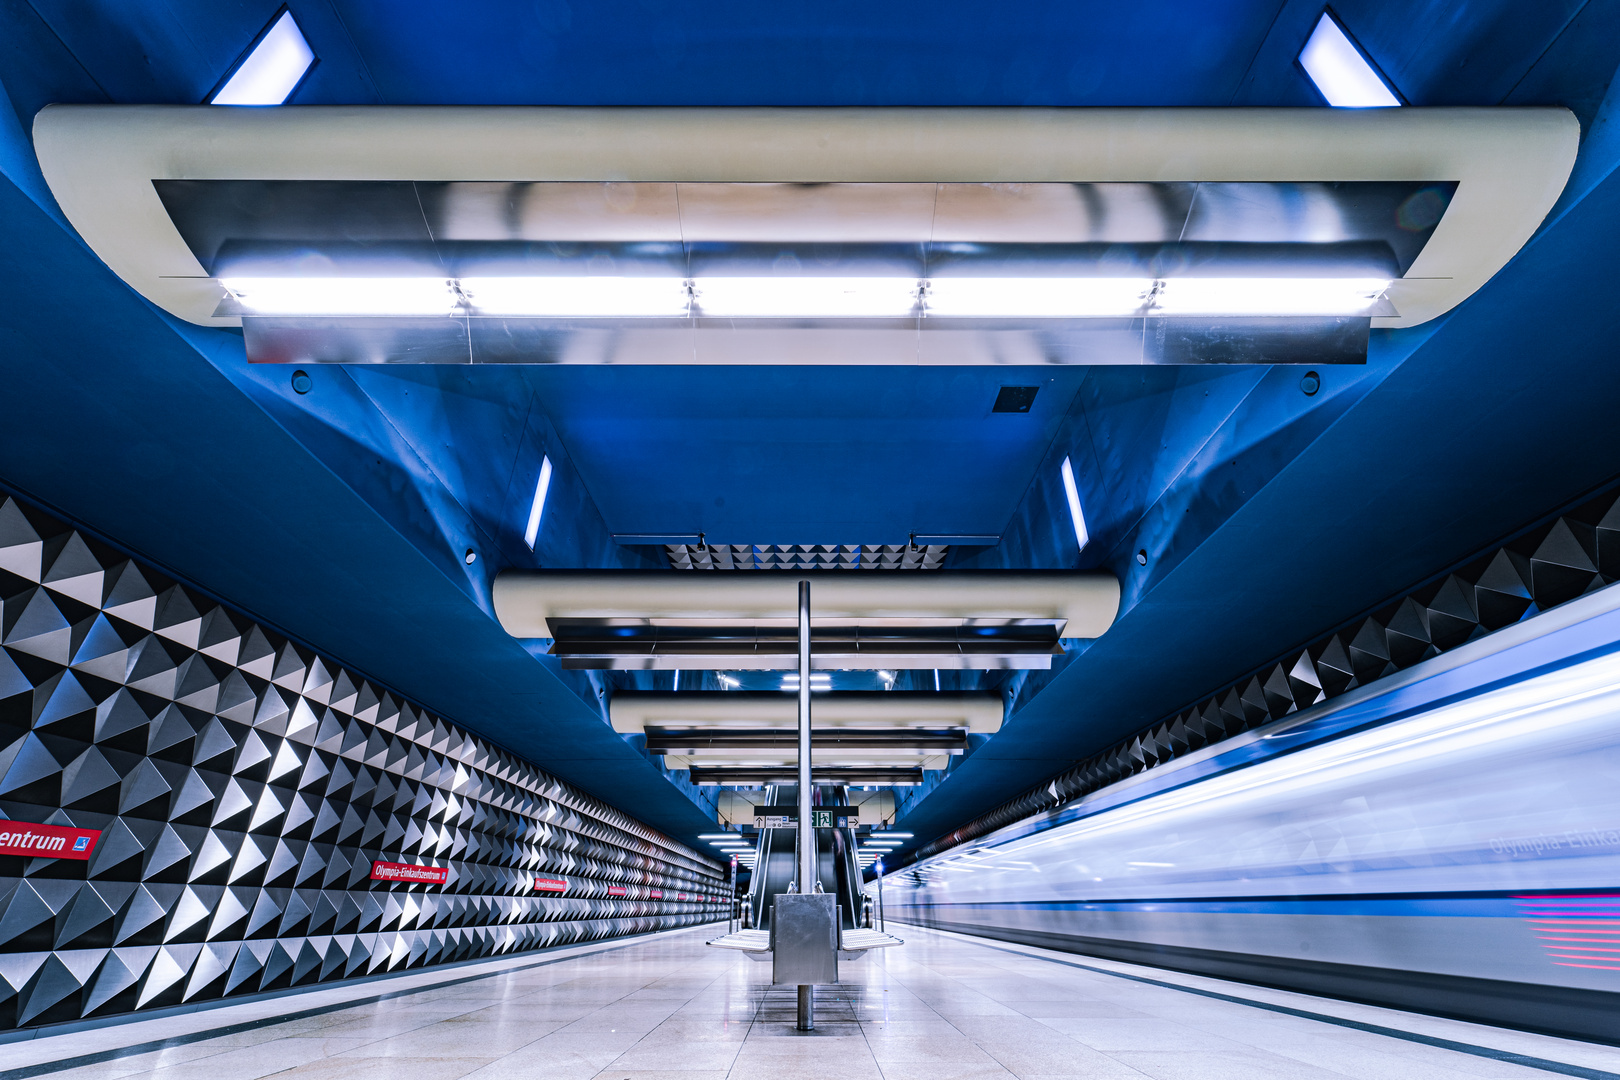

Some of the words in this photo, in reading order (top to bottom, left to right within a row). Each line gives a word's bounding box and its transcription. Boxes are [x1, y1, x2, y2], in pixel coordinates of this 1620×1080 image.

[0, 831, 66, 851] entrum
[1489, 828, 1620, 857] Olympia-Einka
[375, 865, 440, 880] Olympia-Einkaufszentrum
